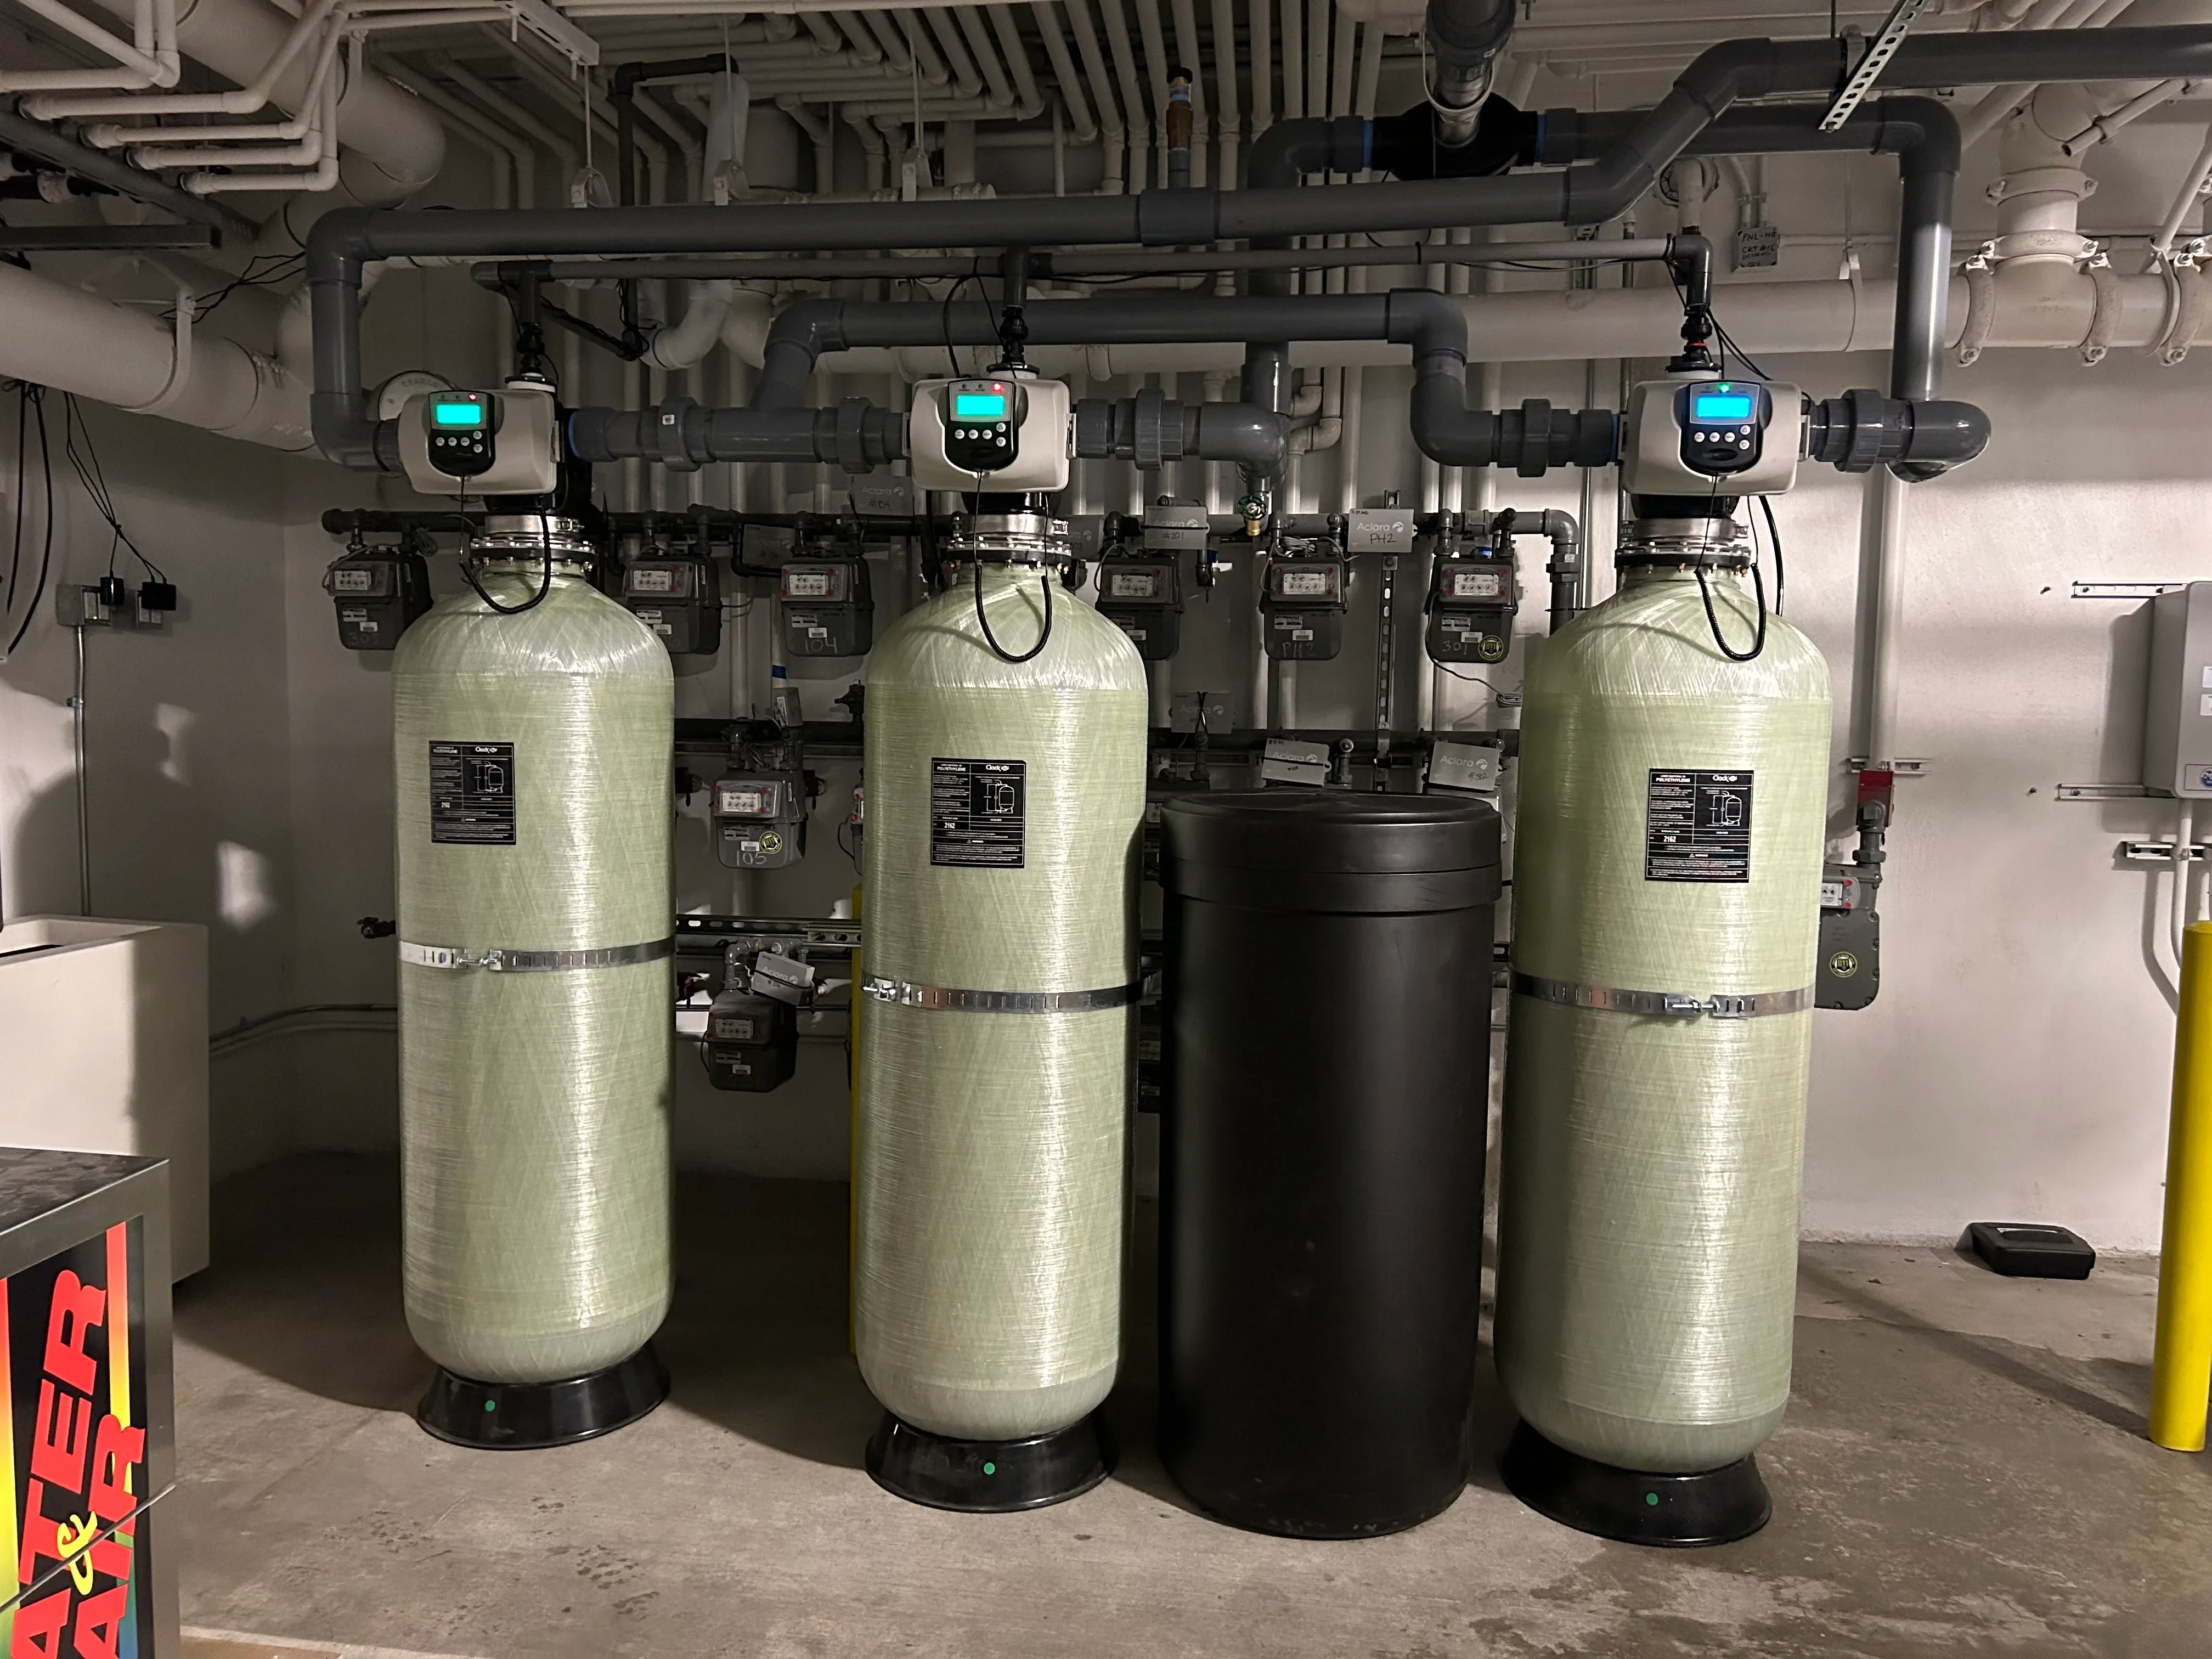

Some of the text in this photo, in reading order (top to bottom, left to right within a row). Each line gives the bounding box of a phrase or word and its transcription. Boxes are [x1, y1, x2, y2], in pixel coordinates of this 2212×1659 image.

[861, 486, 892, 496] Aclara
[1356, 522, 1391, 532] Aclara
[1161, 531, 1184, 540] #201
[1370, 533, 1397, 545] PH2
[805, 636, 838, 654] 104
[1282, 641, 1316, 658] PH2
[1441, 639, 1468, 656] 301
[1180, 704, 1211, 714] Aclaa
[1273, 751, 1304, 762] Aclara
[1440, 754, 1474, 768] Aclara
[737, 849, 768, 867] 105
[1838, 959, 1849, 967] 811
[74, 1414, 146, 1659] AIR
